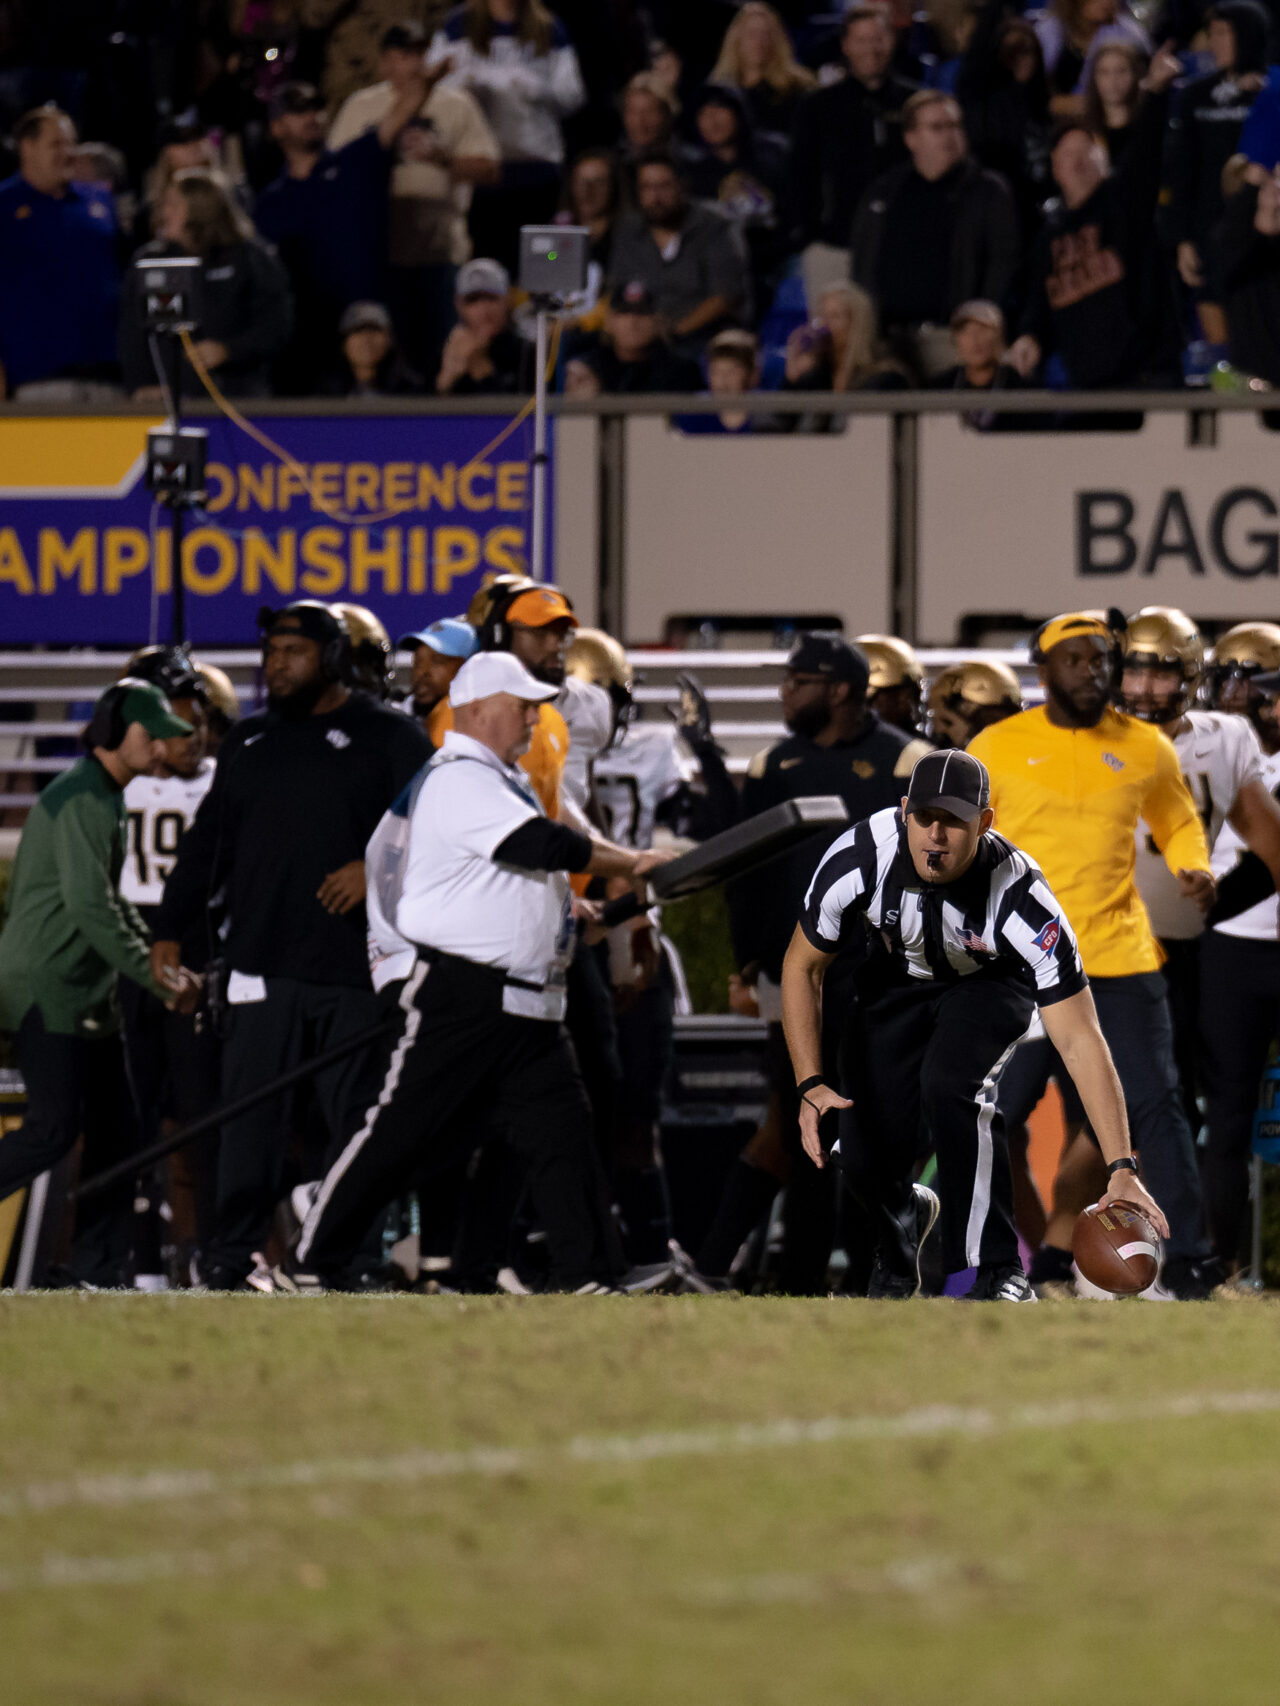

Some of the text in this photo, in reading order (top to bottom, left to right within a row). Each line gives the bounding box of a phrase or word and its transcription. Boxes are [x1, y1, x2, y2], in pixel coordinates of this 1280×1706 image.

[204, 461, 528, 513] ONFERENCE
[124, 806, 185, 884] 19
[1043, 929, 1058, 947] CFO
